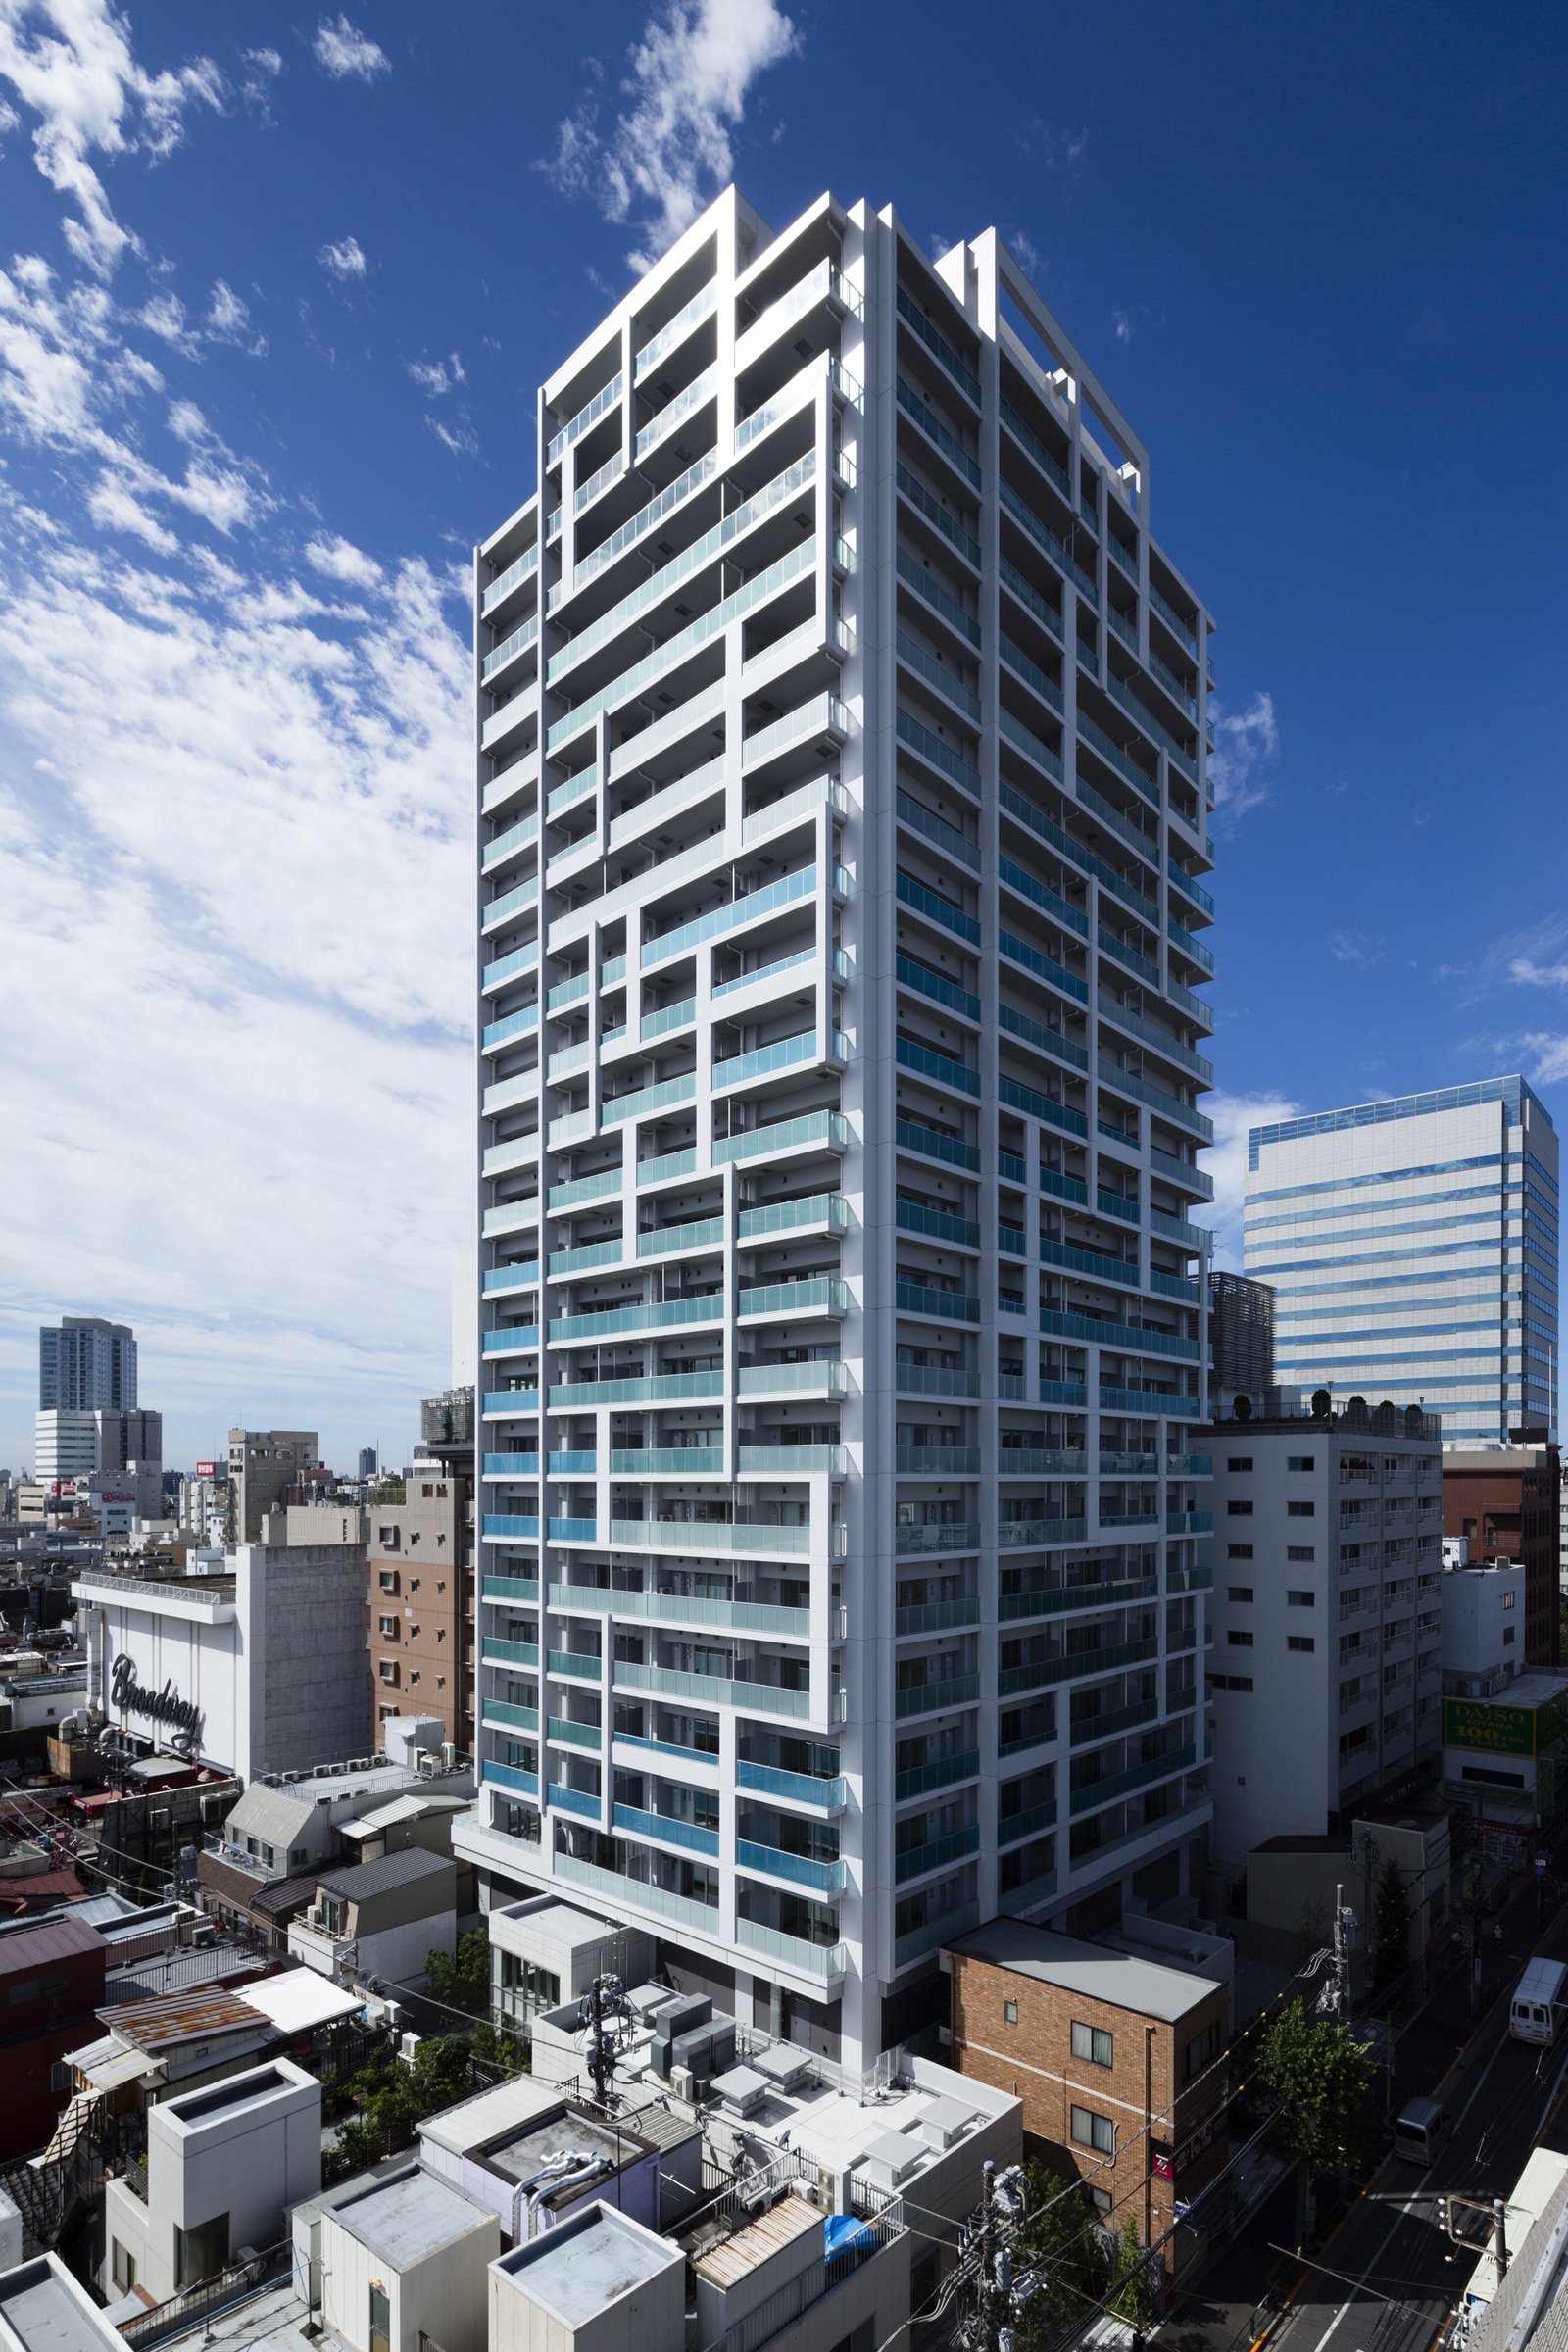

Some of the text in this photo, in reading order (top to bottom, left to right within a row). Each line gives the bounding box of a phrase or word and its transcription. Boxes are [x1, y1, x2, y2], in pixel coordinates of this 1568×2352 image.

[111, 1653, 200, 1754] Broadway
[1455, 1705, 1525, 1724] DAISO
[1465, 1719, 1513, 1730] AOYAMA
[1454, 1725, 1525, 1744] 100 YEN
[1470, 1738, 1508, 1748] PLAZA
